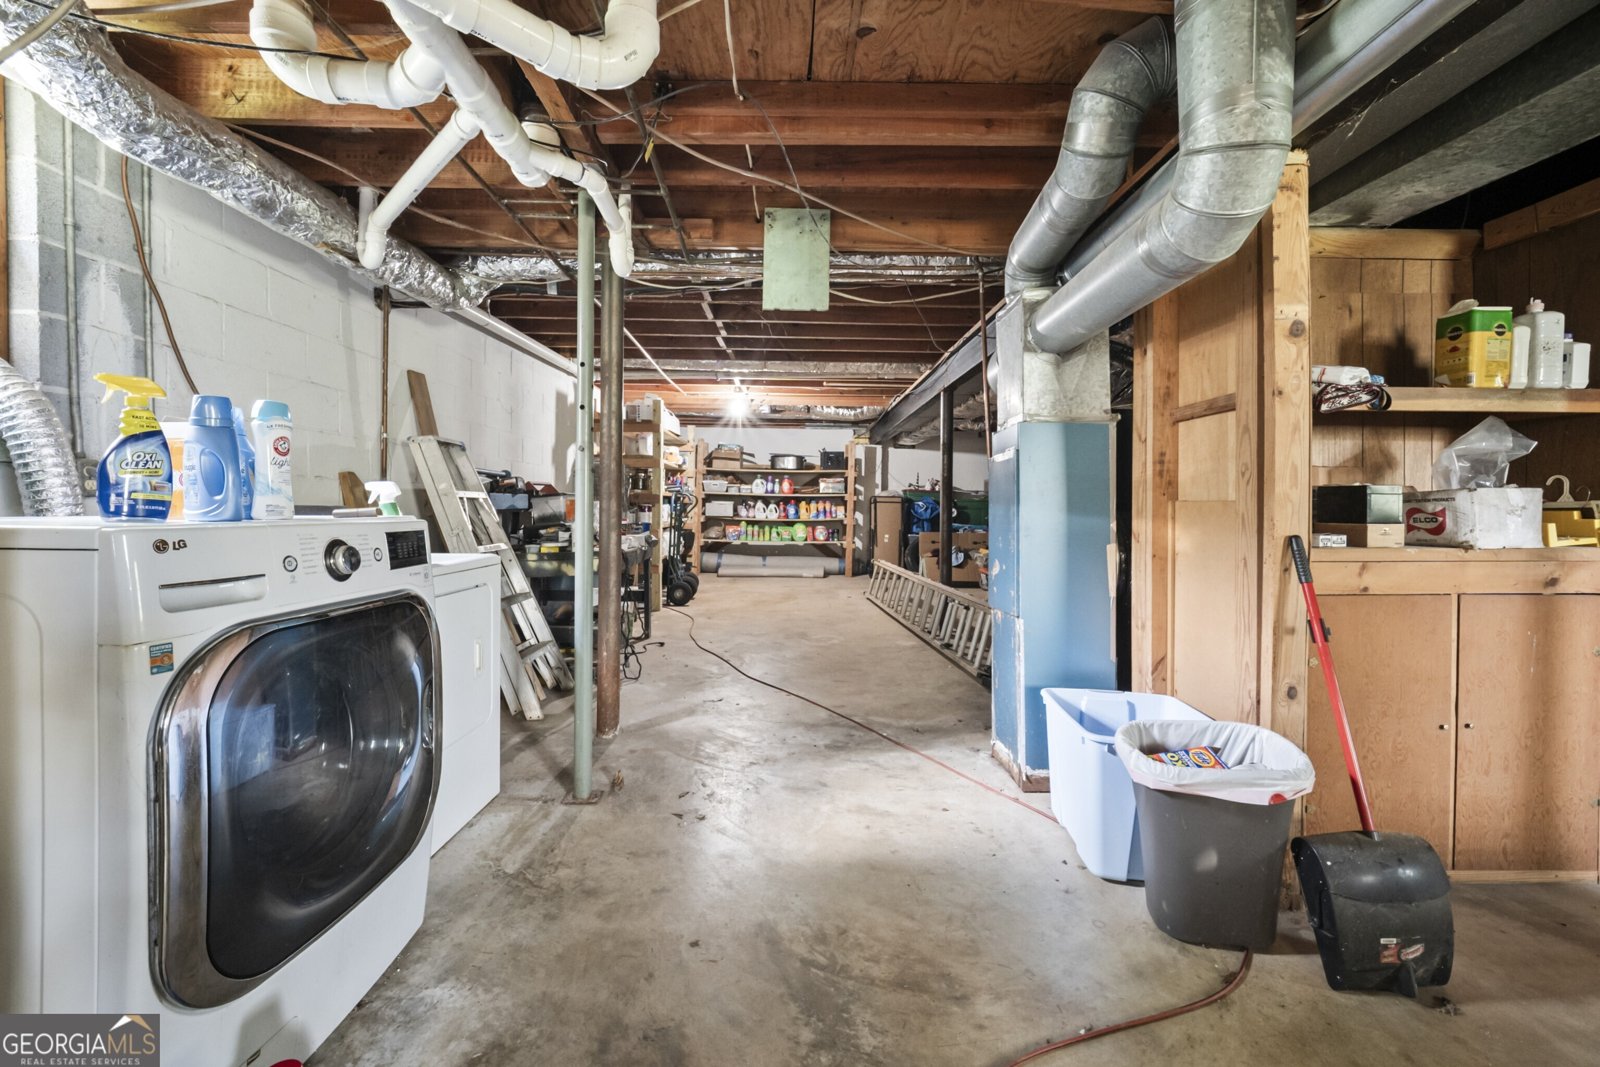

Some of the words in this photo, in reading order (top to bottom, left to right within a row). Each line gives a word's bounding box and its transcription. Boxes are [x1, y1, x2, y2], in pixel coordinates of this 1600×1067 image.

[131, 450, 157, 461] OXI
[120, 459, 163, 469] CLEAN
[172, 539, 188, 551] LG
